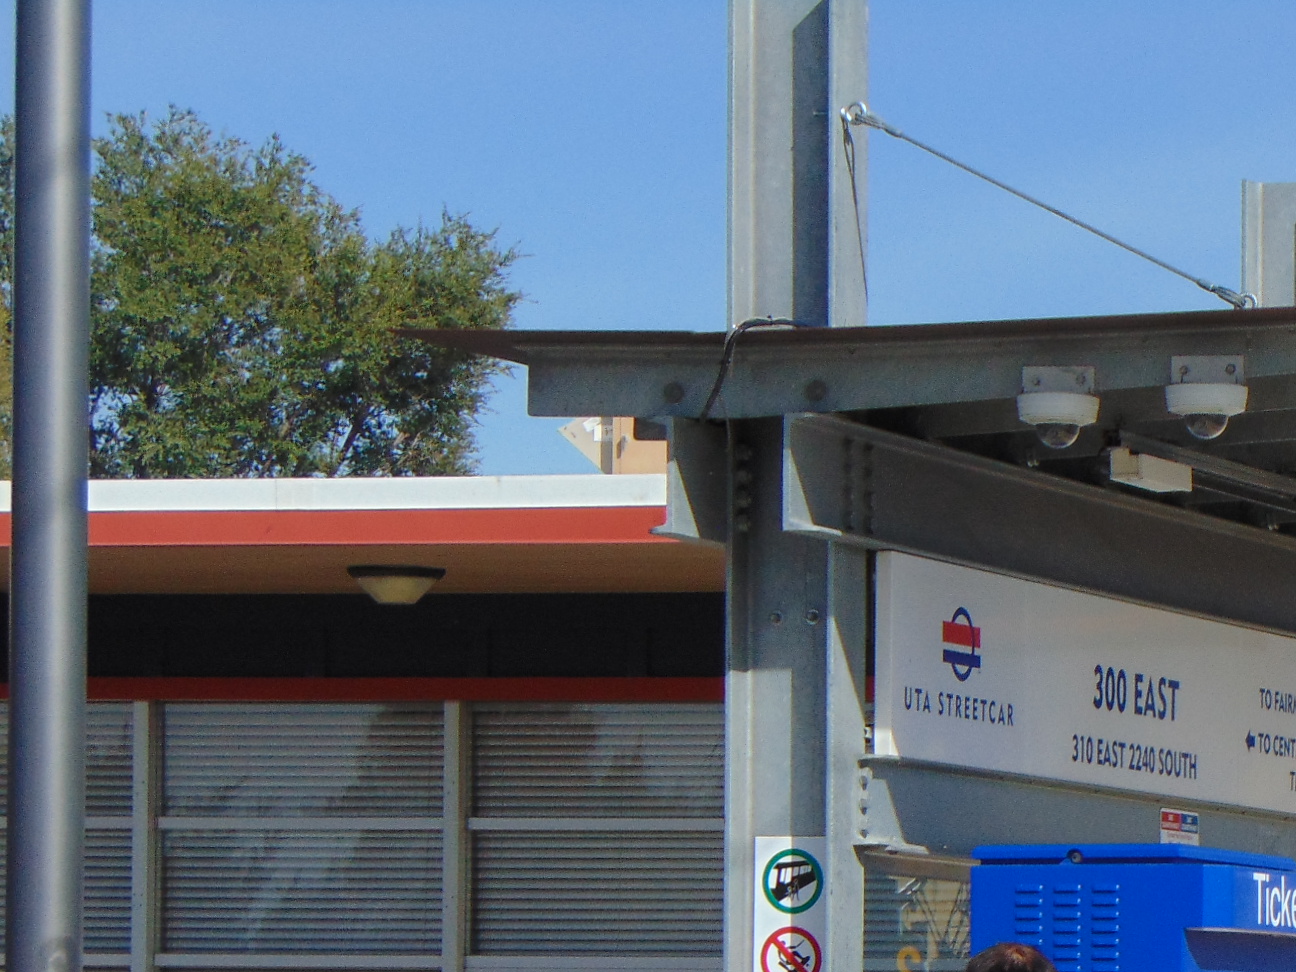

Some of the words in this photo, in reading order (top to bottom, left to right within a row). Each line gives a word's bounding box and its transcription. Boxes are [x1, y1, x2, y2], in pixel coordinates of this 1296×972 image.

[904, 686, 931, 713] UTA
[938, 691, 1014, 726] STREETCAR
[1093, 664, 1127, 713] 300
[1134, 673, 1180, 721] EAST
[1259, 688, 1272, 710] TO
[1072, 733, 1093, 764] 310
[1096, 738, 1126, 768] EAST
[1128, 743, 1155, 774] 2240
[1158, 748, 1197, 780] SOUTH
[1258, 732, 1271, 755] TO
